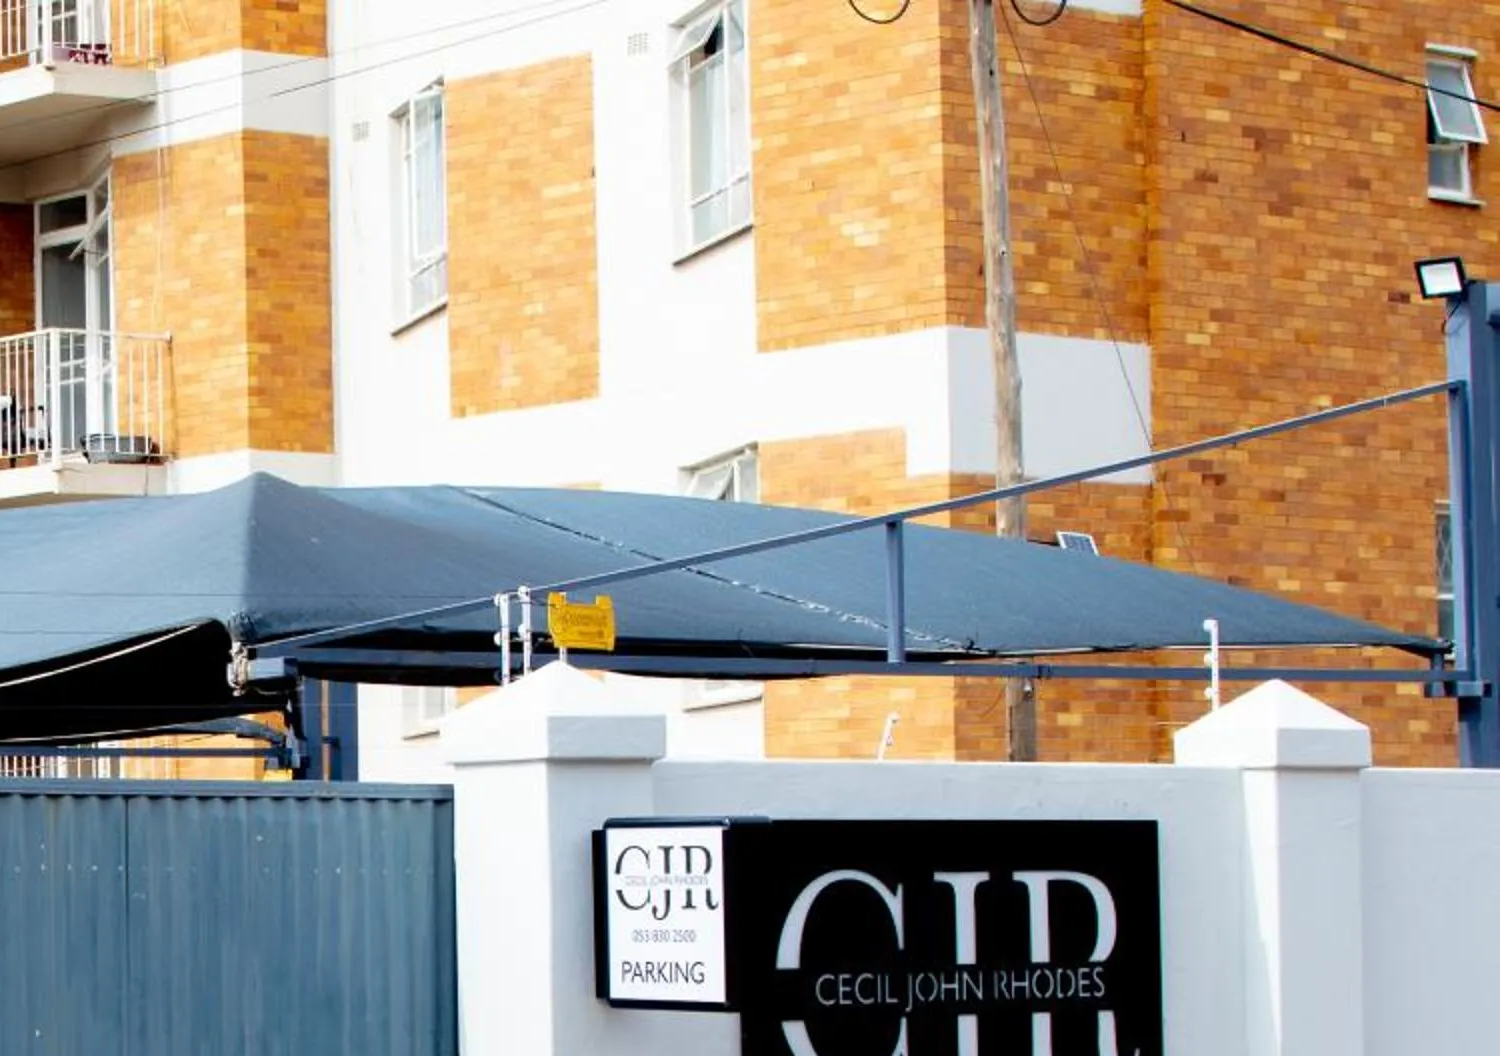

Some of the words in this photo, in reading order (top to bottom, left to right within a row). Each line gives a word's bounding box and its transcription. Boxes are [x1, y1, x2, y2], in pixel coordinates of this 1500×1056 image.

[615, 845, 718, 920] CJR
[621, 960, 705, 985] PARKING
[815, 973, 898, 1006] CECIL
[905, 971, 983, 1012] JOHN
[994, 967, 1105, 999] RHODES
